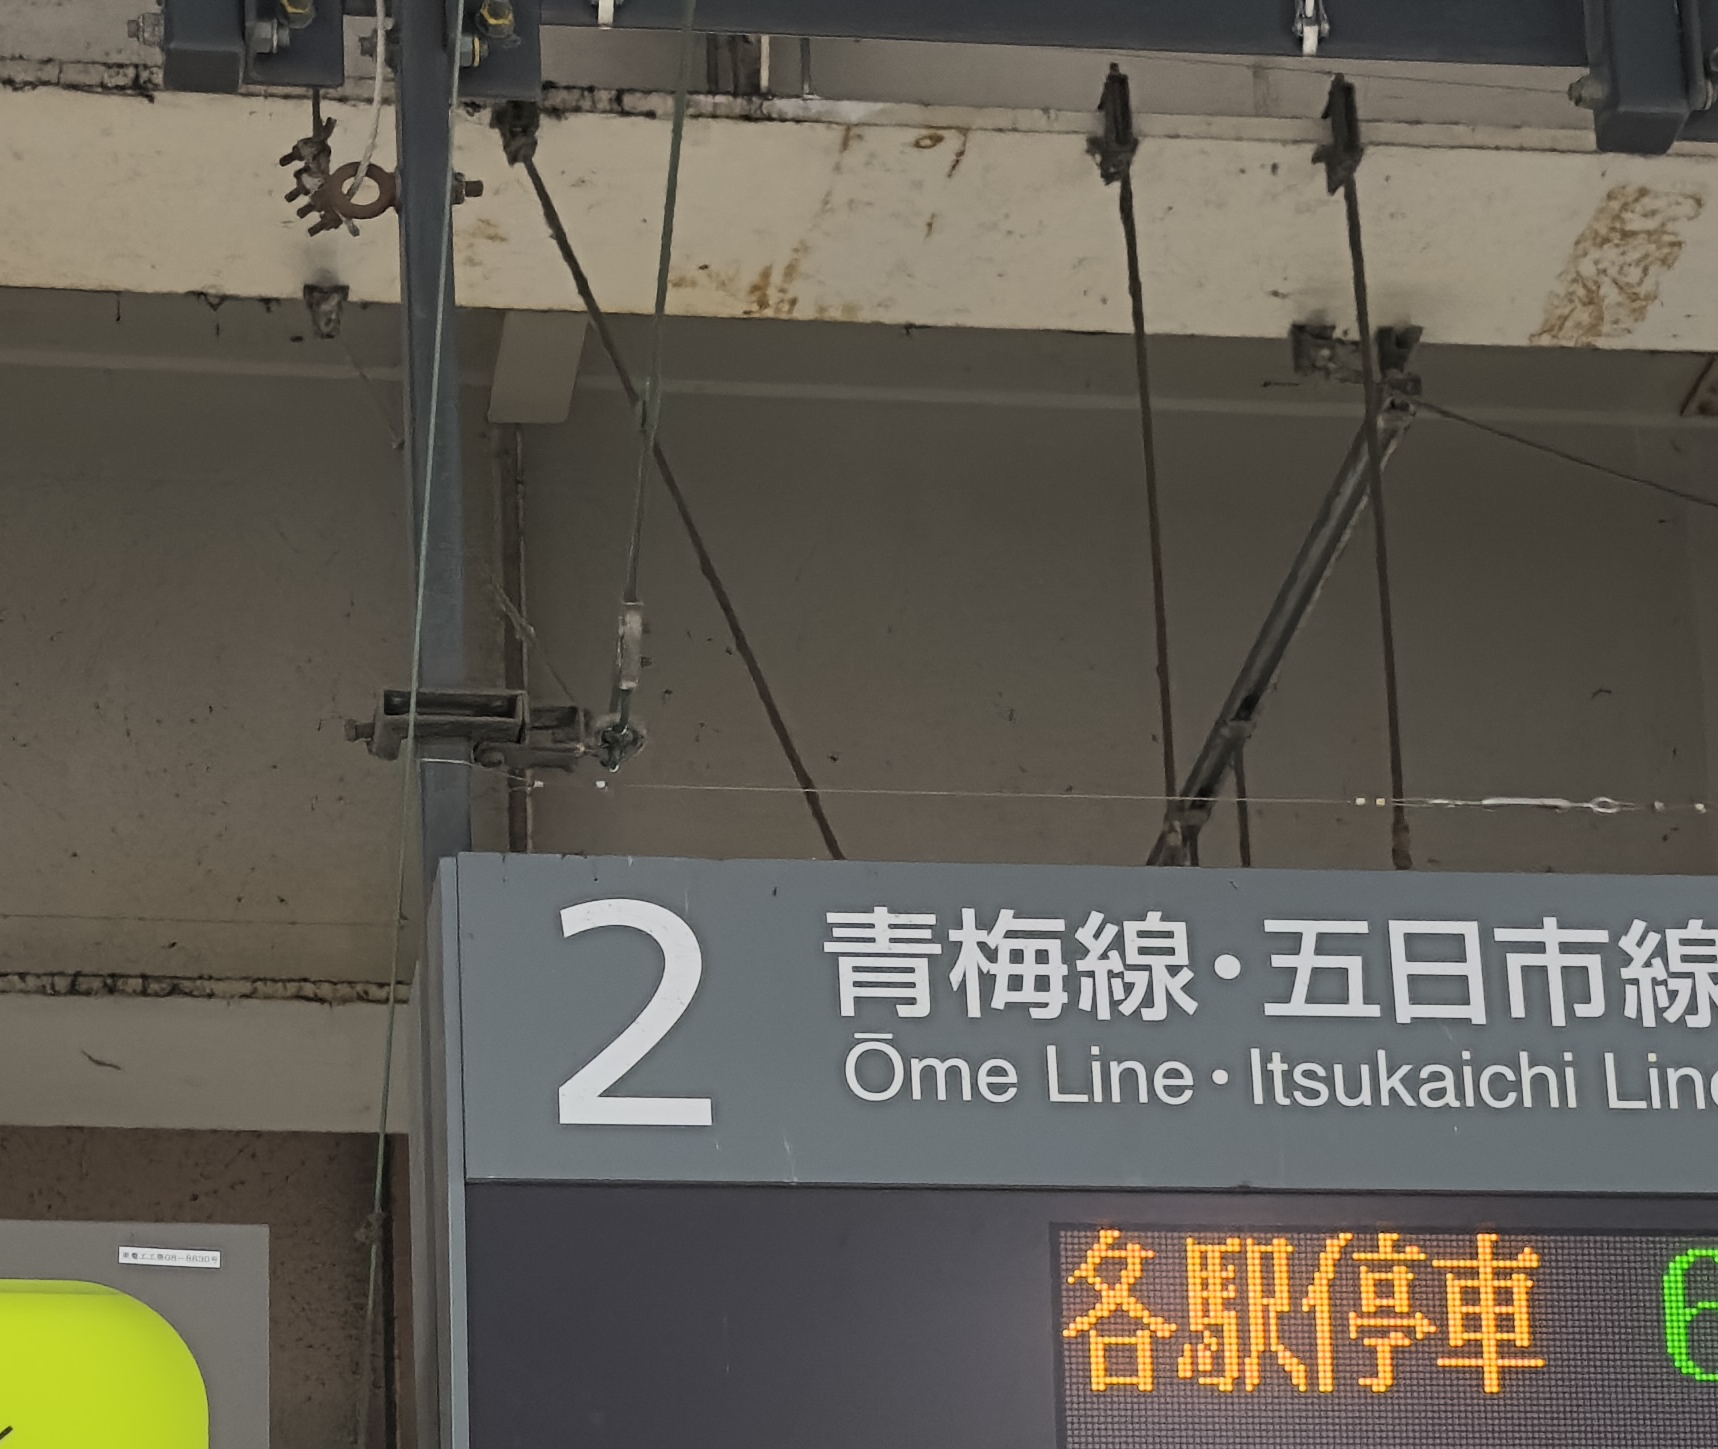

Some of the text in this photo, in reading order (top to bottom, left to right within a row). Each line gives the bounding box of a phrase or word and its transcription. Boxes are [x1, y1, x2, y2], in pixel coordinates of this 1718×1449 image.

[556, 898, 714, 1127] 2
[845, 1032, 1018, 1106] Ōme
[1063, 1228, 1546, 1393] 各駅停車
